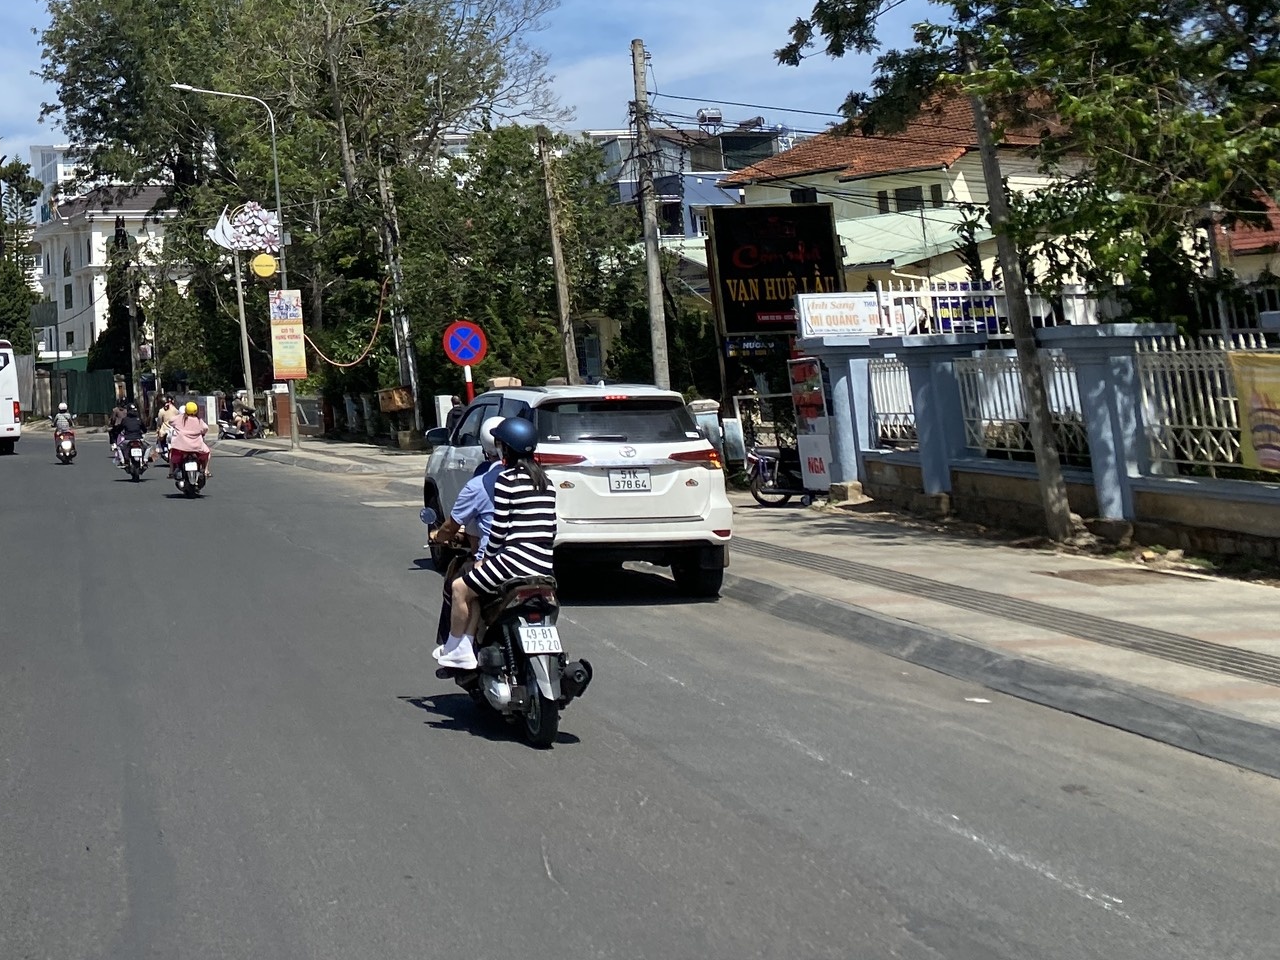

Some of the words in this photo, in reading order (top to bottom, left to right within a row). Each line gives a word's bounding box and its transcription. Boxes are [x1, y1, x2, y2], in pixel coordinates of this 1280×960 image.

[808, 457, 826, 475] NGA
[621, 470, 639, 479] 51K
[615, 480, 647, 489] 378.64
